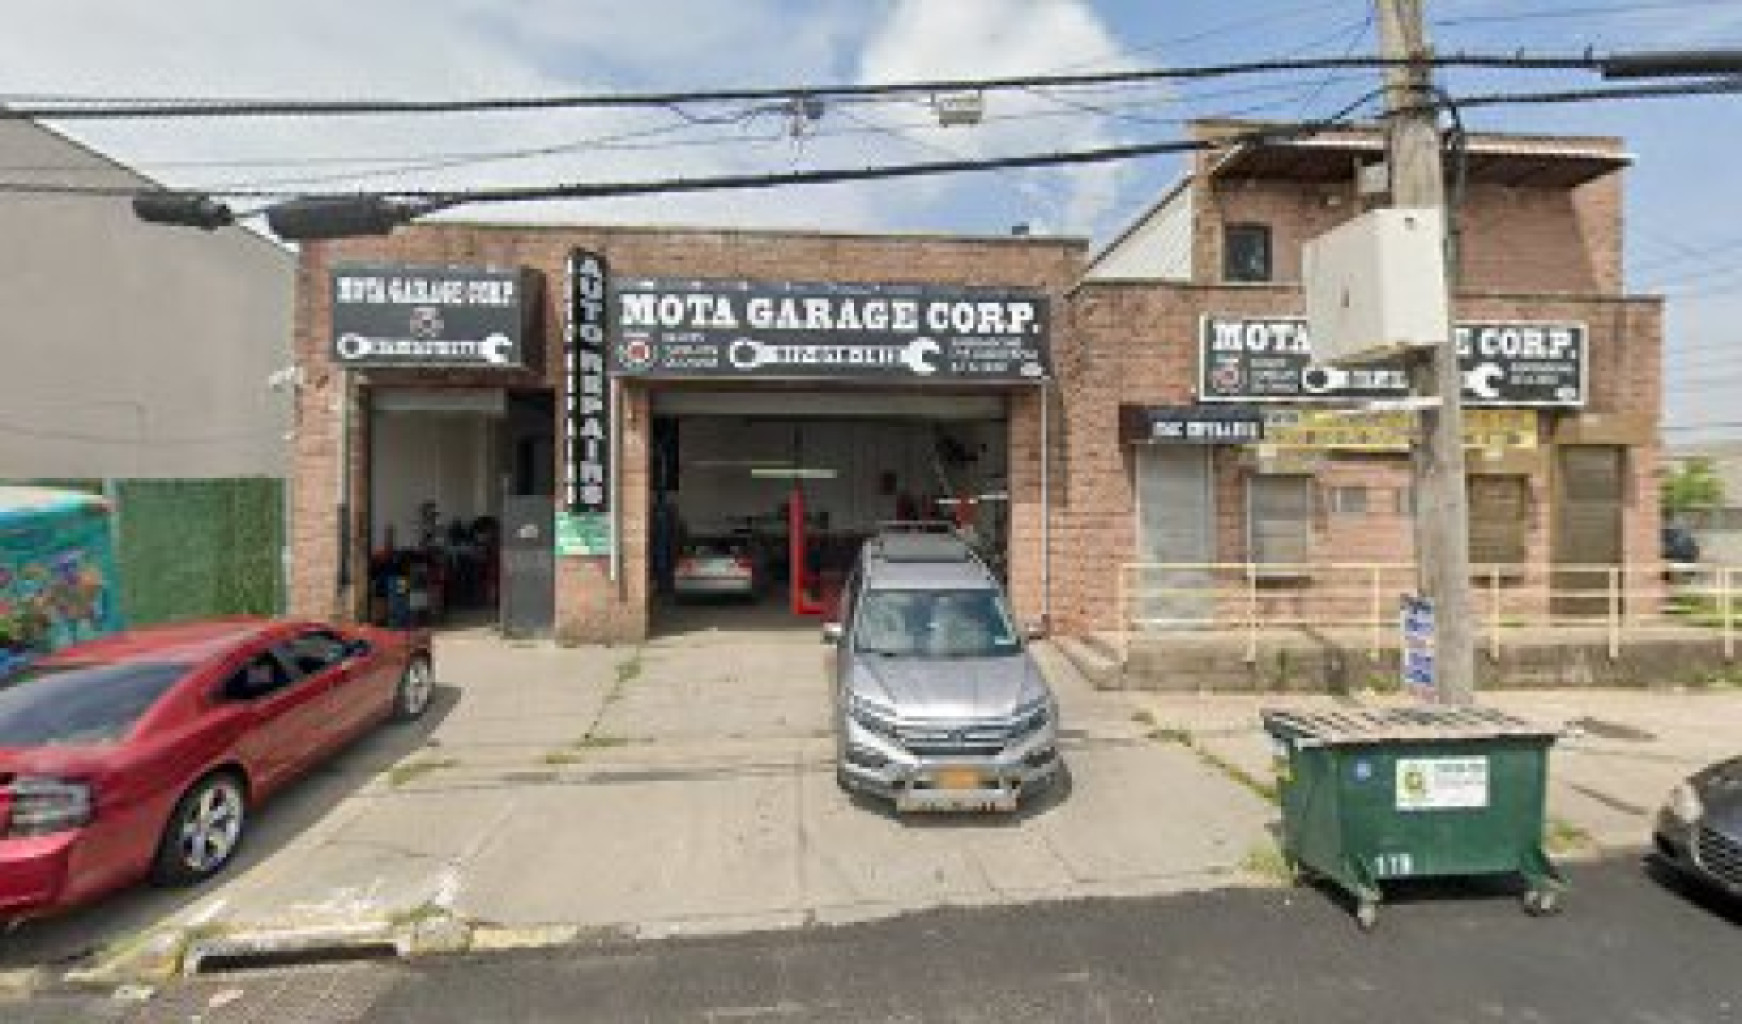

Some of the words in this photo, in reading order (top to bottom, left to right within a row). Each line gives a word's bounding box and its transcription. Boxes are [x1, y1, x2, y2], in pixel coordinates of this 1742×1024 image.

[580, 259, 602, 342] AUTO
[619, 293, 739, 328] MOTA
[746, 298, 920, 332] GARAGE
[926, 302, 1042, 334] CORP.
